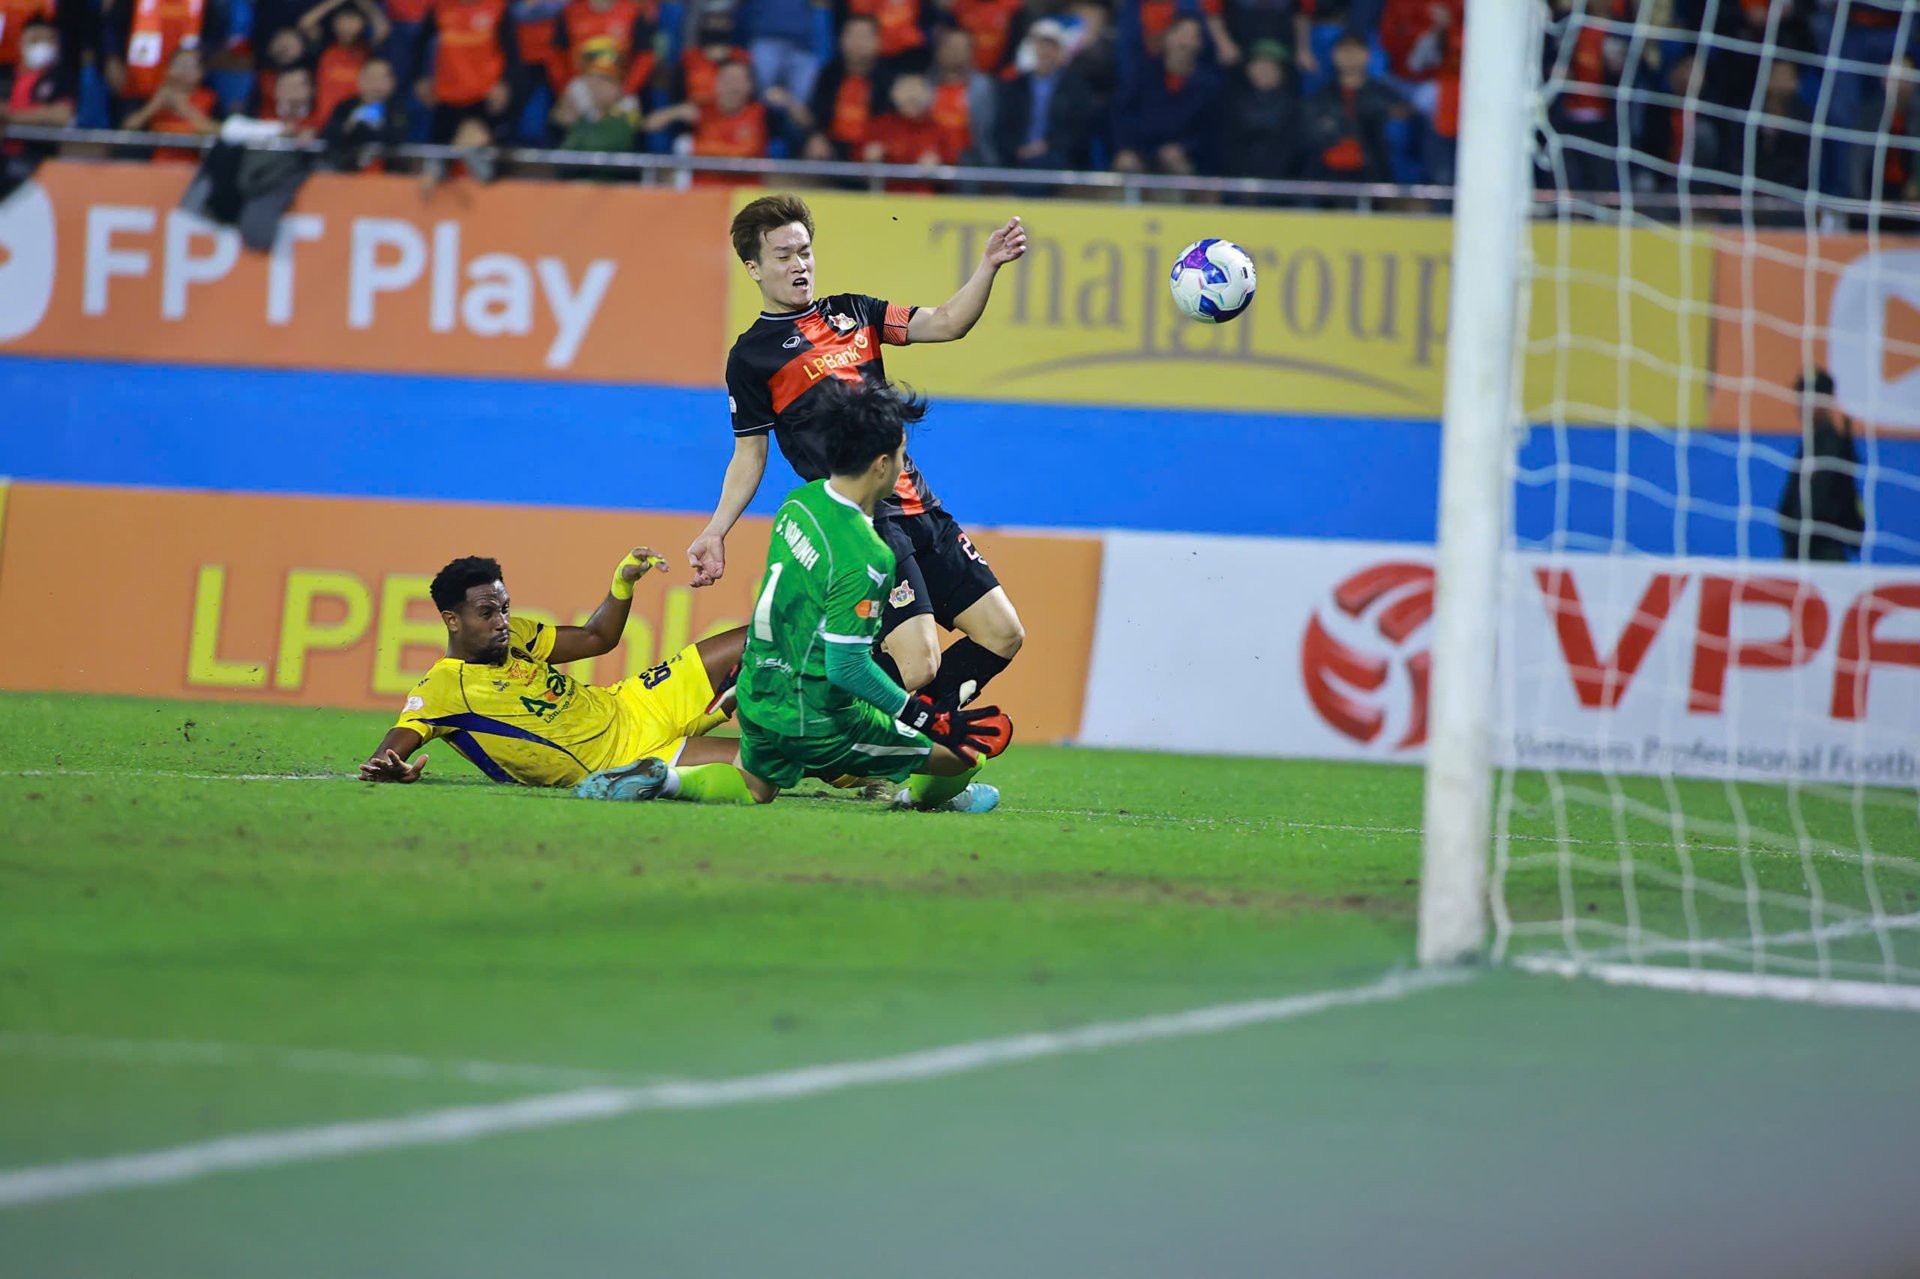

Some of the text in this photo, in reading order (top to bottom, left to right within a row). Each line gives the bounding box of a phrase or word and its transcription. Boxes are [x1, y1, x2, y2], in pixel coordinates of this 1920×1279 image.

[81, 204, 618, 369] FPT Play
[802, 345, 862, 381] LPBank
[754, 561, 784, 643] 1
